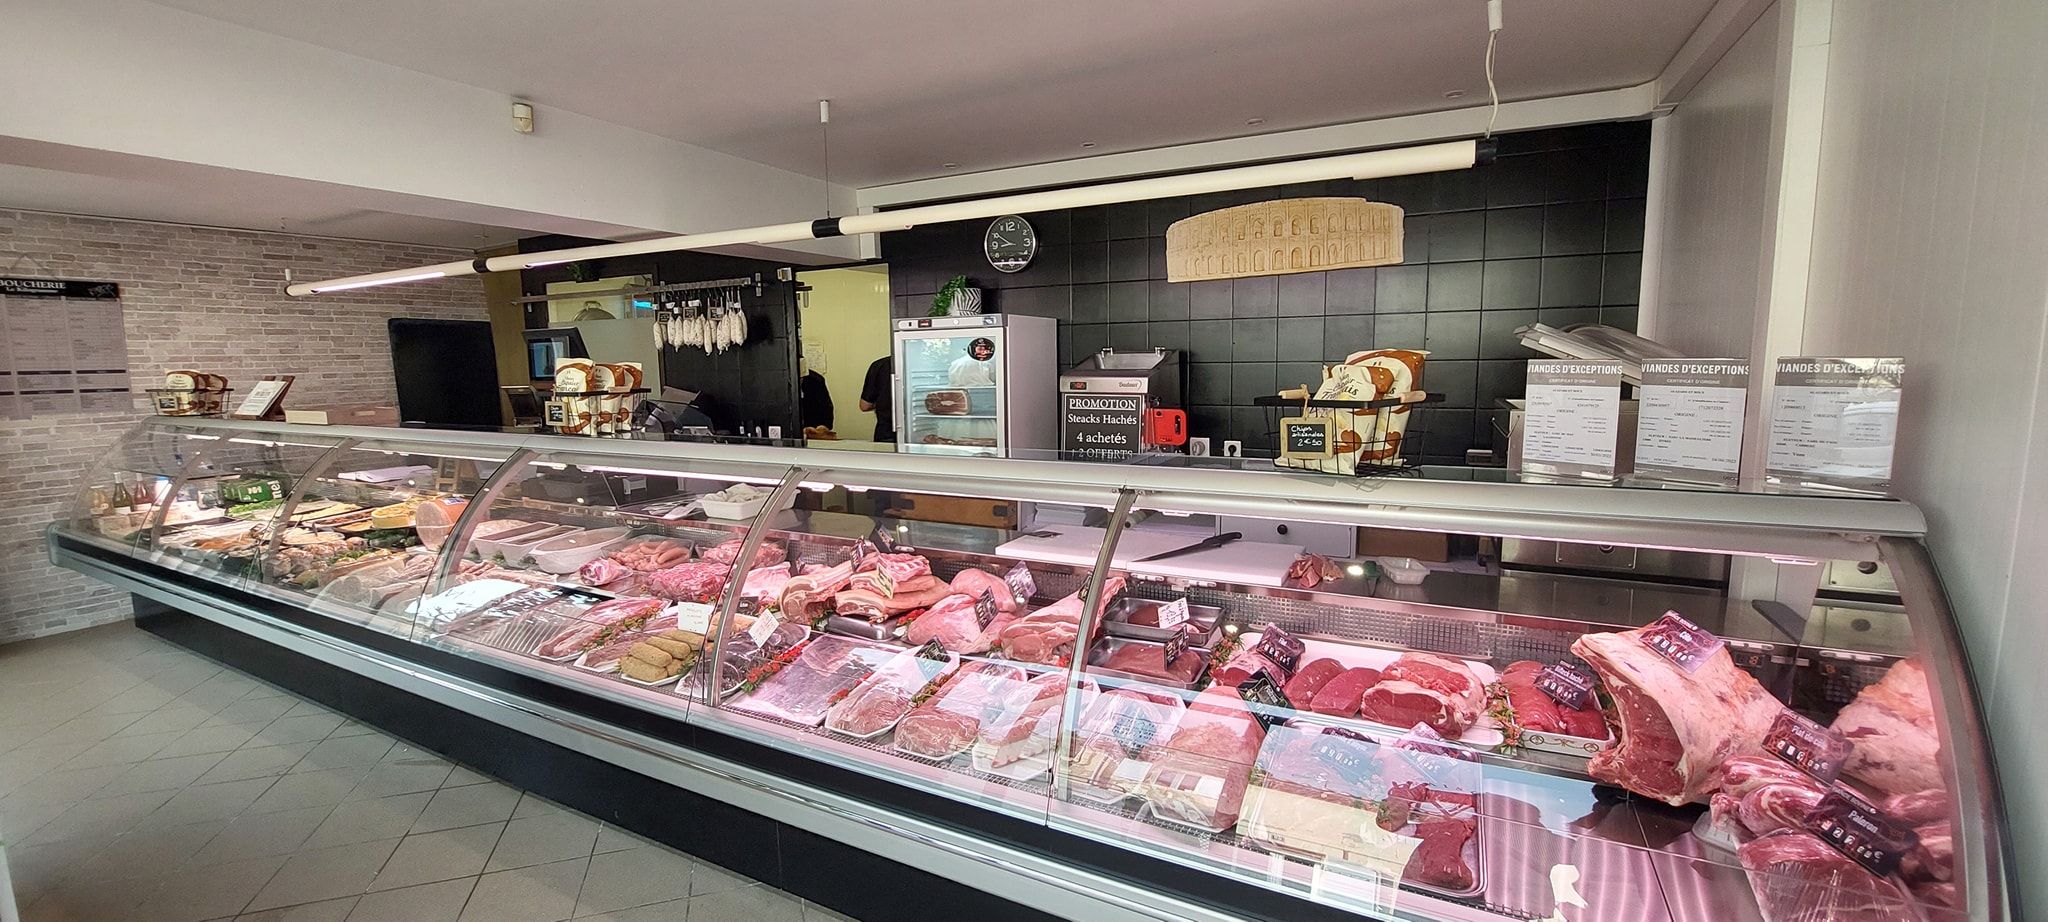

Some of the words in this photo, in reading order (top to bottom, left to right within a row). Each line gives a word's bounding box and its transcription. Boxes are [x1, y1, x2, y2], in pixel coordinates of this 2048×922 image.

[1005, 221, 1016, 232] 12
[991, 241, 999, 250] 9
[1023, 237, 1031, 247] 3
[1562, 365, 1623, 375] D'EXCEPTIONS
[1641, 363, 1680, 373] VIANDES
[1069, 398, 1137, 410] PROMOTION
[1067, 413, 1101, 424] Steacks
[1102, 414, 1138, 426] Hachés
[1290, 425, 1313, 434] Chips
[1076, 432, 1084, 443] 4
[1085, 431, 1127, 444] achetés
[1848, 810, 1879, 834] Paleron
